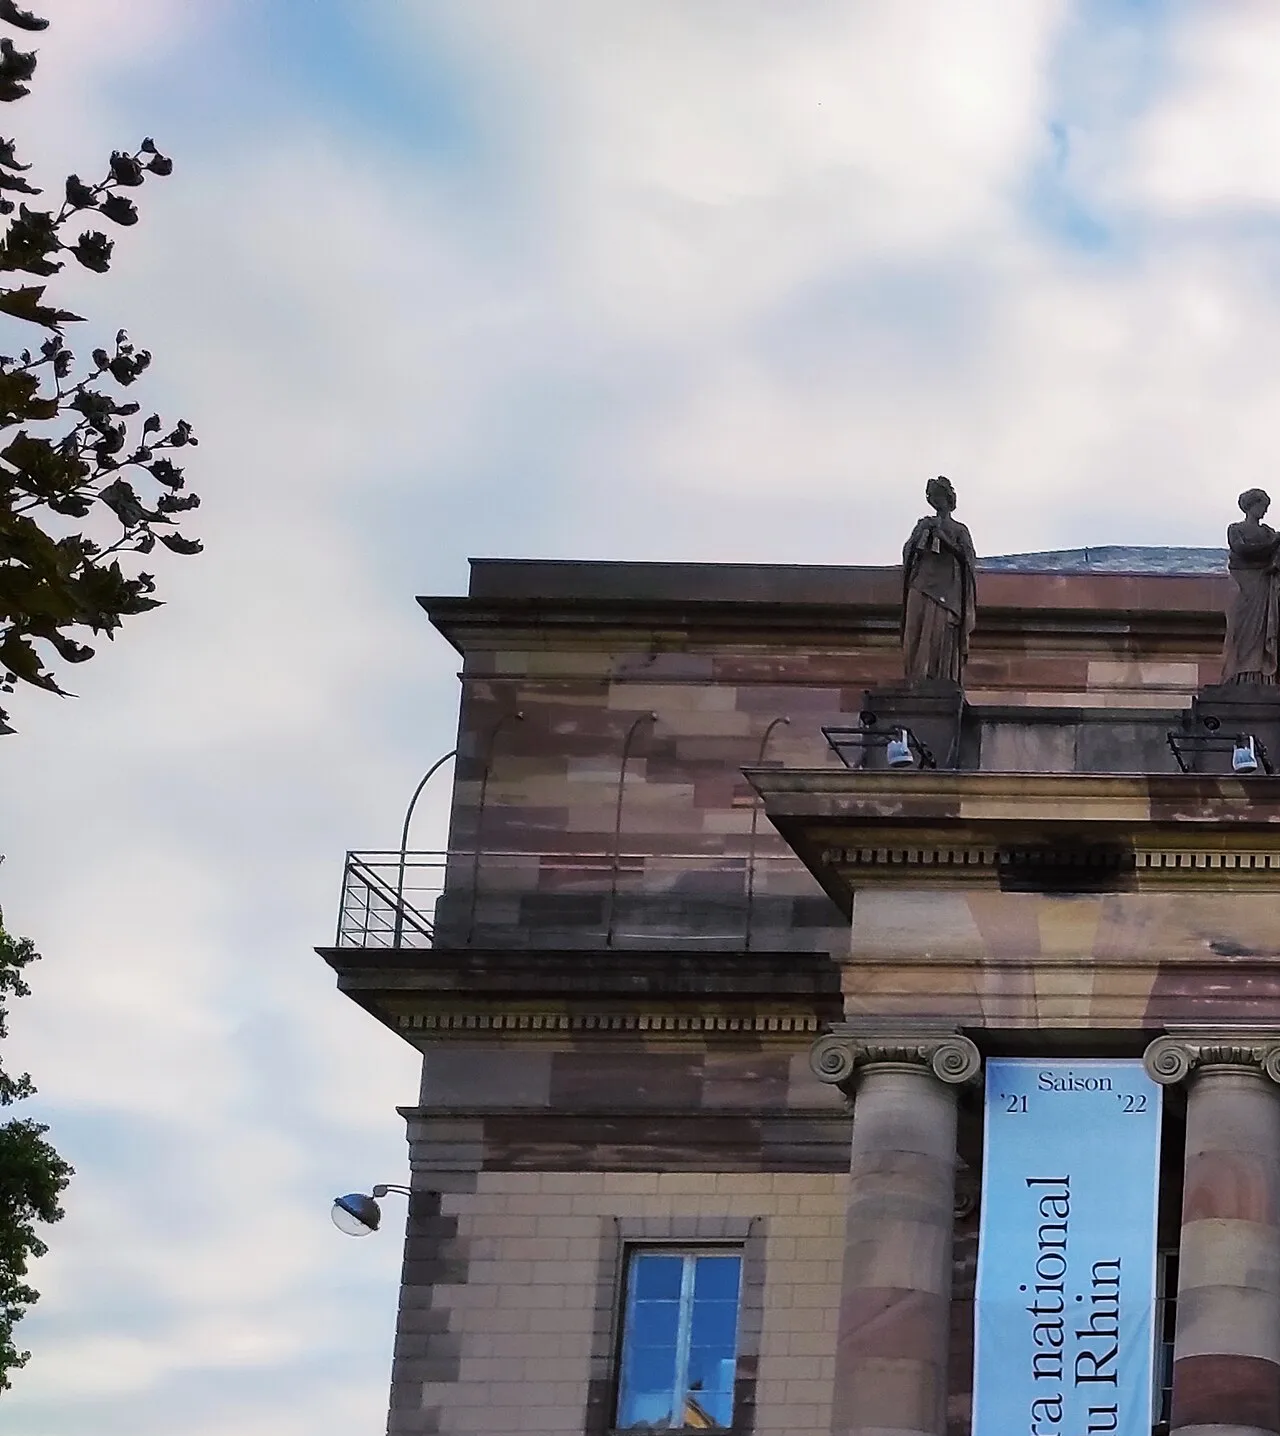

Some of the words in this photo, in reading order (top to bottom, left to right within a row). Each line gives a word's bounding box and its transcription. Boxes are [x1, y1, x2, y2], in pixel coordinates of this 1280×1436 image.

[1038, 1072, 1112, 1091] Saison
[1020, 1175, 1070, 1381] national
[1075, 1258, 1121, 1388] Rhin
